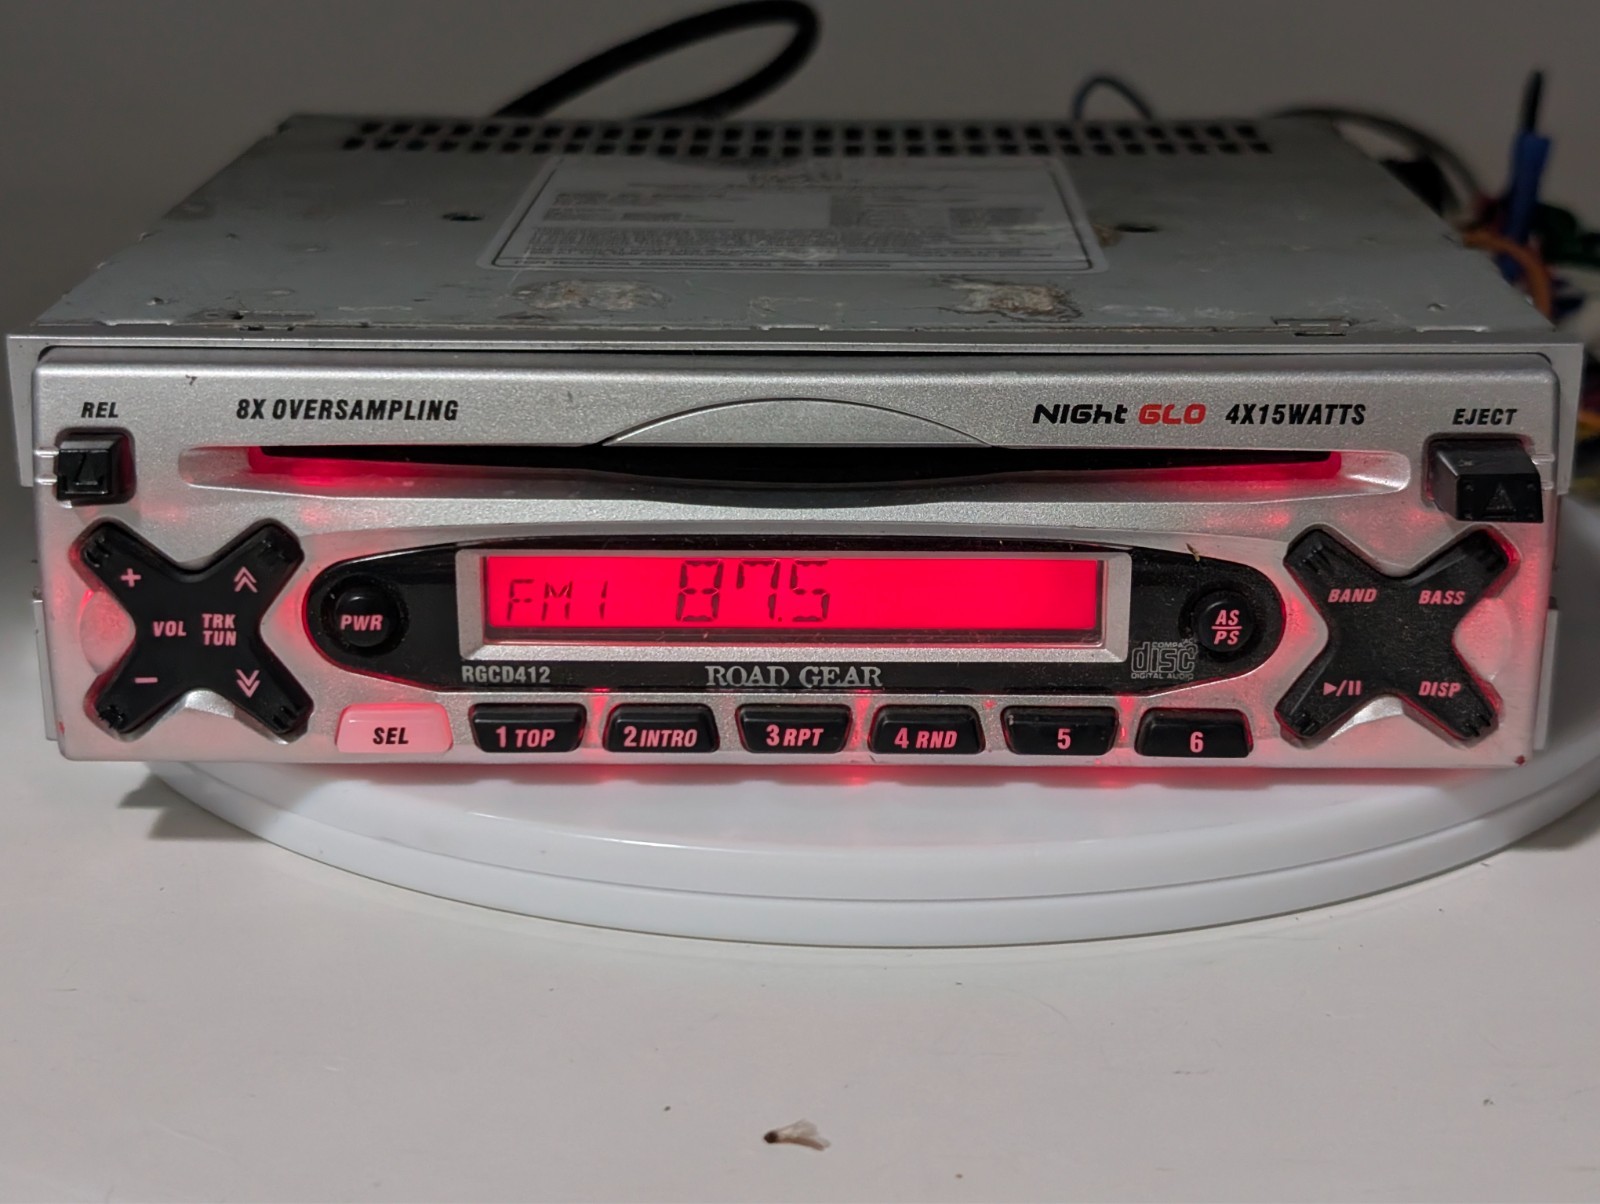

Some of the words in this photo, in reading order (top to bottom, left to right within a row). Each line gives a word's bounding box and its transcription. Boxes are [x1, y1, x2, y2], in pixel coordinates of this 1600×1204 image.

[81, 402, 119, 418] REL
[236, 400, 266, 421] 8X
[272, 401, 460, 421] OVERSAMPLING
[1138, 404, 1206, 425] GLO
[1225, 404, 1366, 425] 4X15WATTS
[1452, 409, 1518, 425] EJECT
[1328, 588, 1378, 603] BAND
[1418, 590, 1466, 606] BASS
[202, 614, 236, 629] TRK
[340, 615, 383, 631] PWR
[1215, 609, 1240, 626] AS
[153, 620, 187, 637] VOL
[203, 631, 237, 646] TUN
[1214, 630, 1240, 646] PS
[461, 665, 551, 684] RGCD412
[705, 665, 790, 687] ROAD
[799, 665, 883, 688] GEAR
[1131, 672, 1163, 680] DIGITAL
[1418, 681, 1463, 698] DISP
[372, 727, 410, 745] SEL
[496, 726, 507, 748] 1
[515, 729, 555, 748] TOP
[623, 726, 638, 747] 2
[640, 729, 698, 748] INTRO
[765, 724, 780, 746] 3
[783, 727, 824, 747] RPT
[894, 727, 909, 749] 4
[915, 731, 958, 749] RND
[1057, 729, 1071, 750] 5
[1189, 731, 1204, 753] 6
